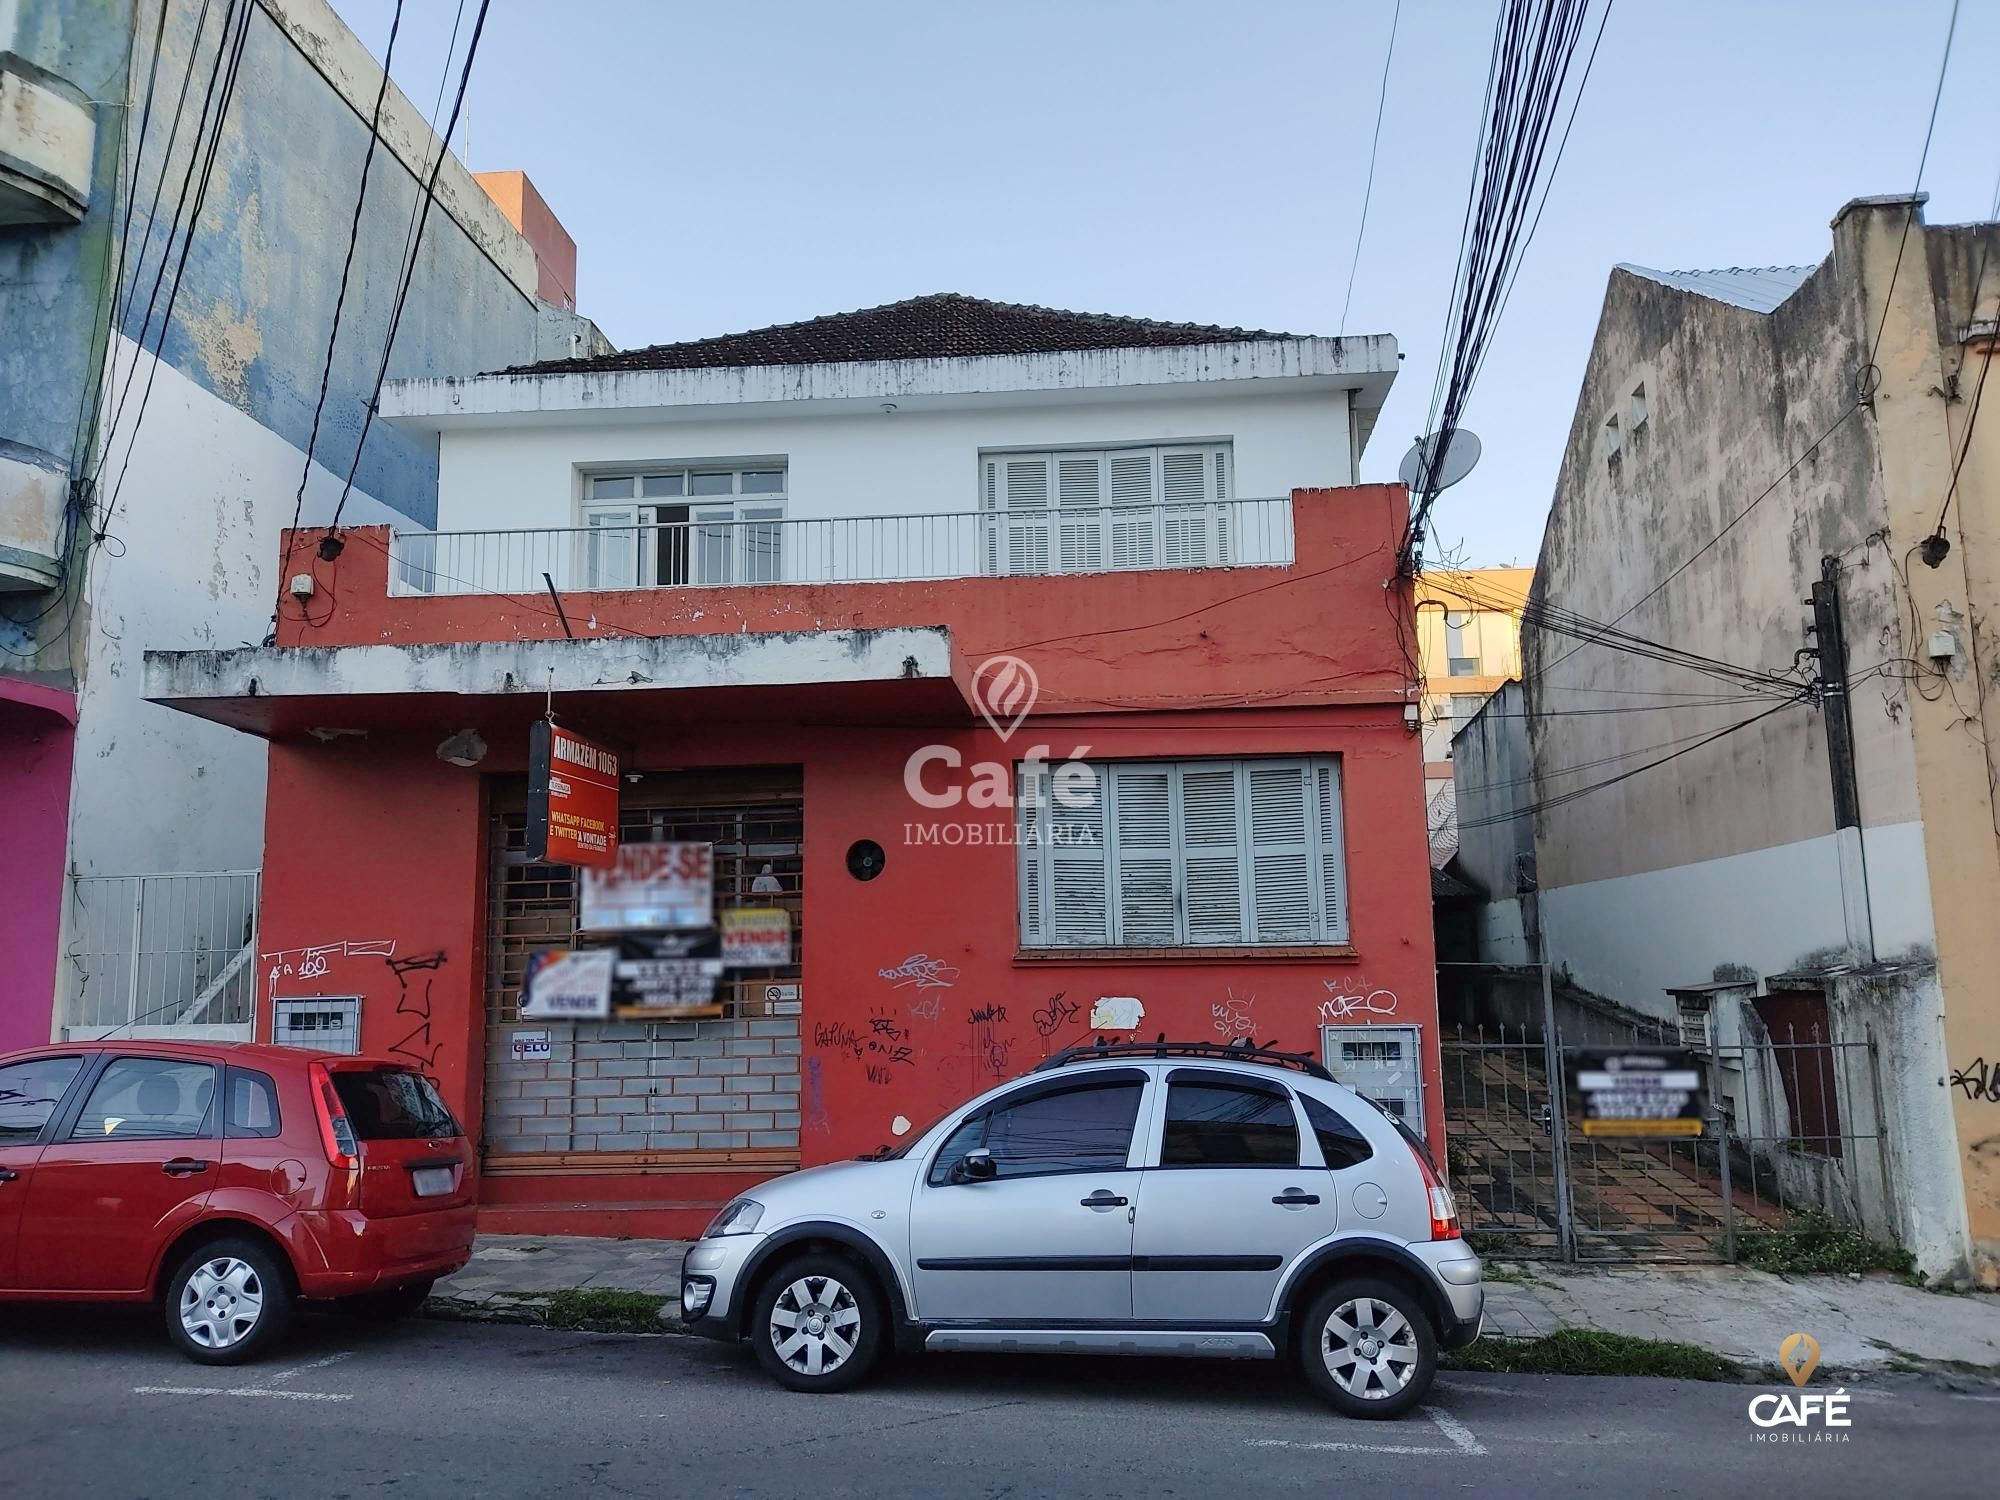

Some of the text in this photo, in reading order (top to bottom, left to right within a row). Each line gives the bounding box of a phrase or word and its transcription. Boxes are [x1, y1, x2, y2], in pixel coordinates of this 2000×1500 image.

[553, 735, 618, 776] ARMAZÉM 1063
[551, 811, 605, 832] WHATSAPP FACEBOOK
[549, 824, 554, 835] E
[555, 825, 577, 839] TWITTER
[583, 832, 607, 846] VONTADE
[513, 1043, 550, 1052] GELO
